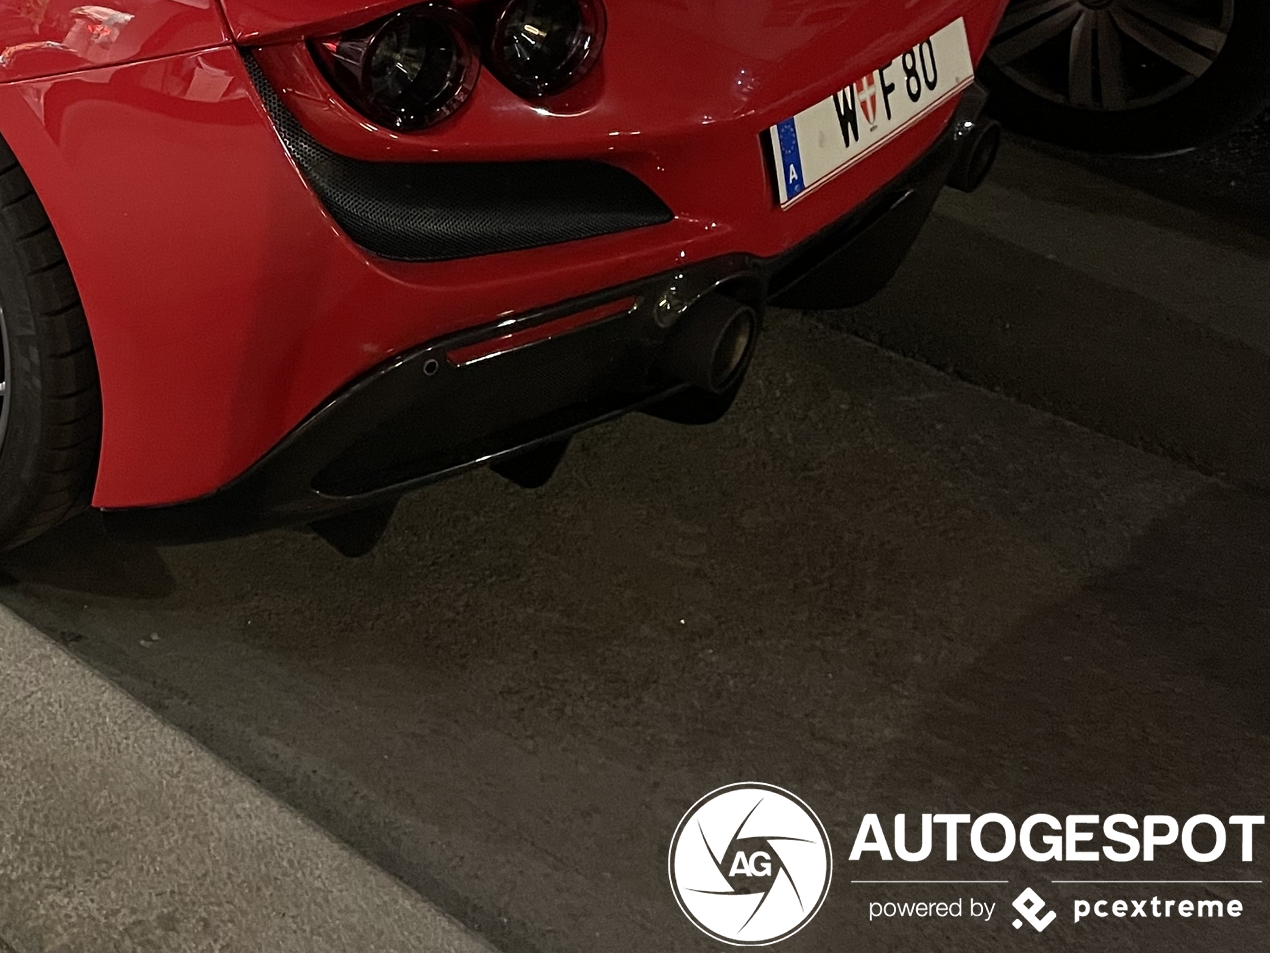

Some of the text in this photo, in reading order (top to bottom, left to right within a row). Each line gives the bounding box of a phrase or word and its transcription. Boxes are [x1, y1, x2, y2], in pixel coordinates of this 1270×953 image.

[833, 36, 938, 149] W F 80
[788, 163, 799, 185] A
